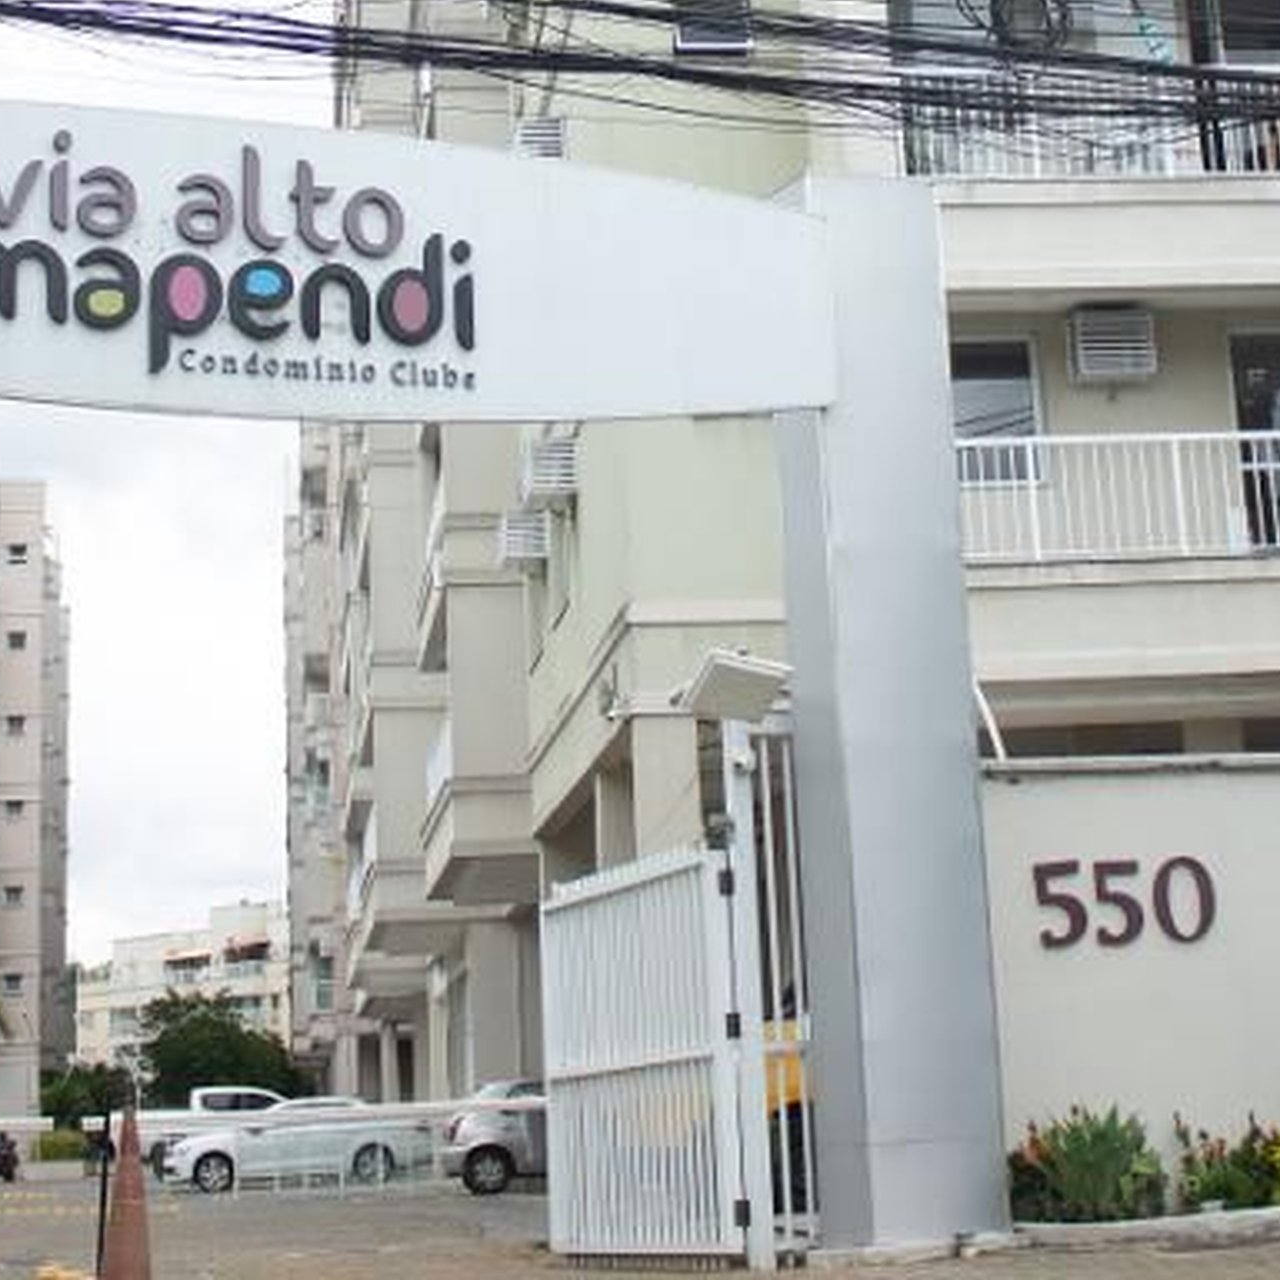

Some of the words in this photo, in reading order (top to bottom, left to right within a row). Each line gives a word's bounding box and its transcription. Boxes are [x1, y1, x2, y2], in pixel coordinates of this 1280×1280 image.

[174, 144, 405, 260] alto
[389, 361, 477, 390] Clube
[1032, 855, 1217, 950] 550
